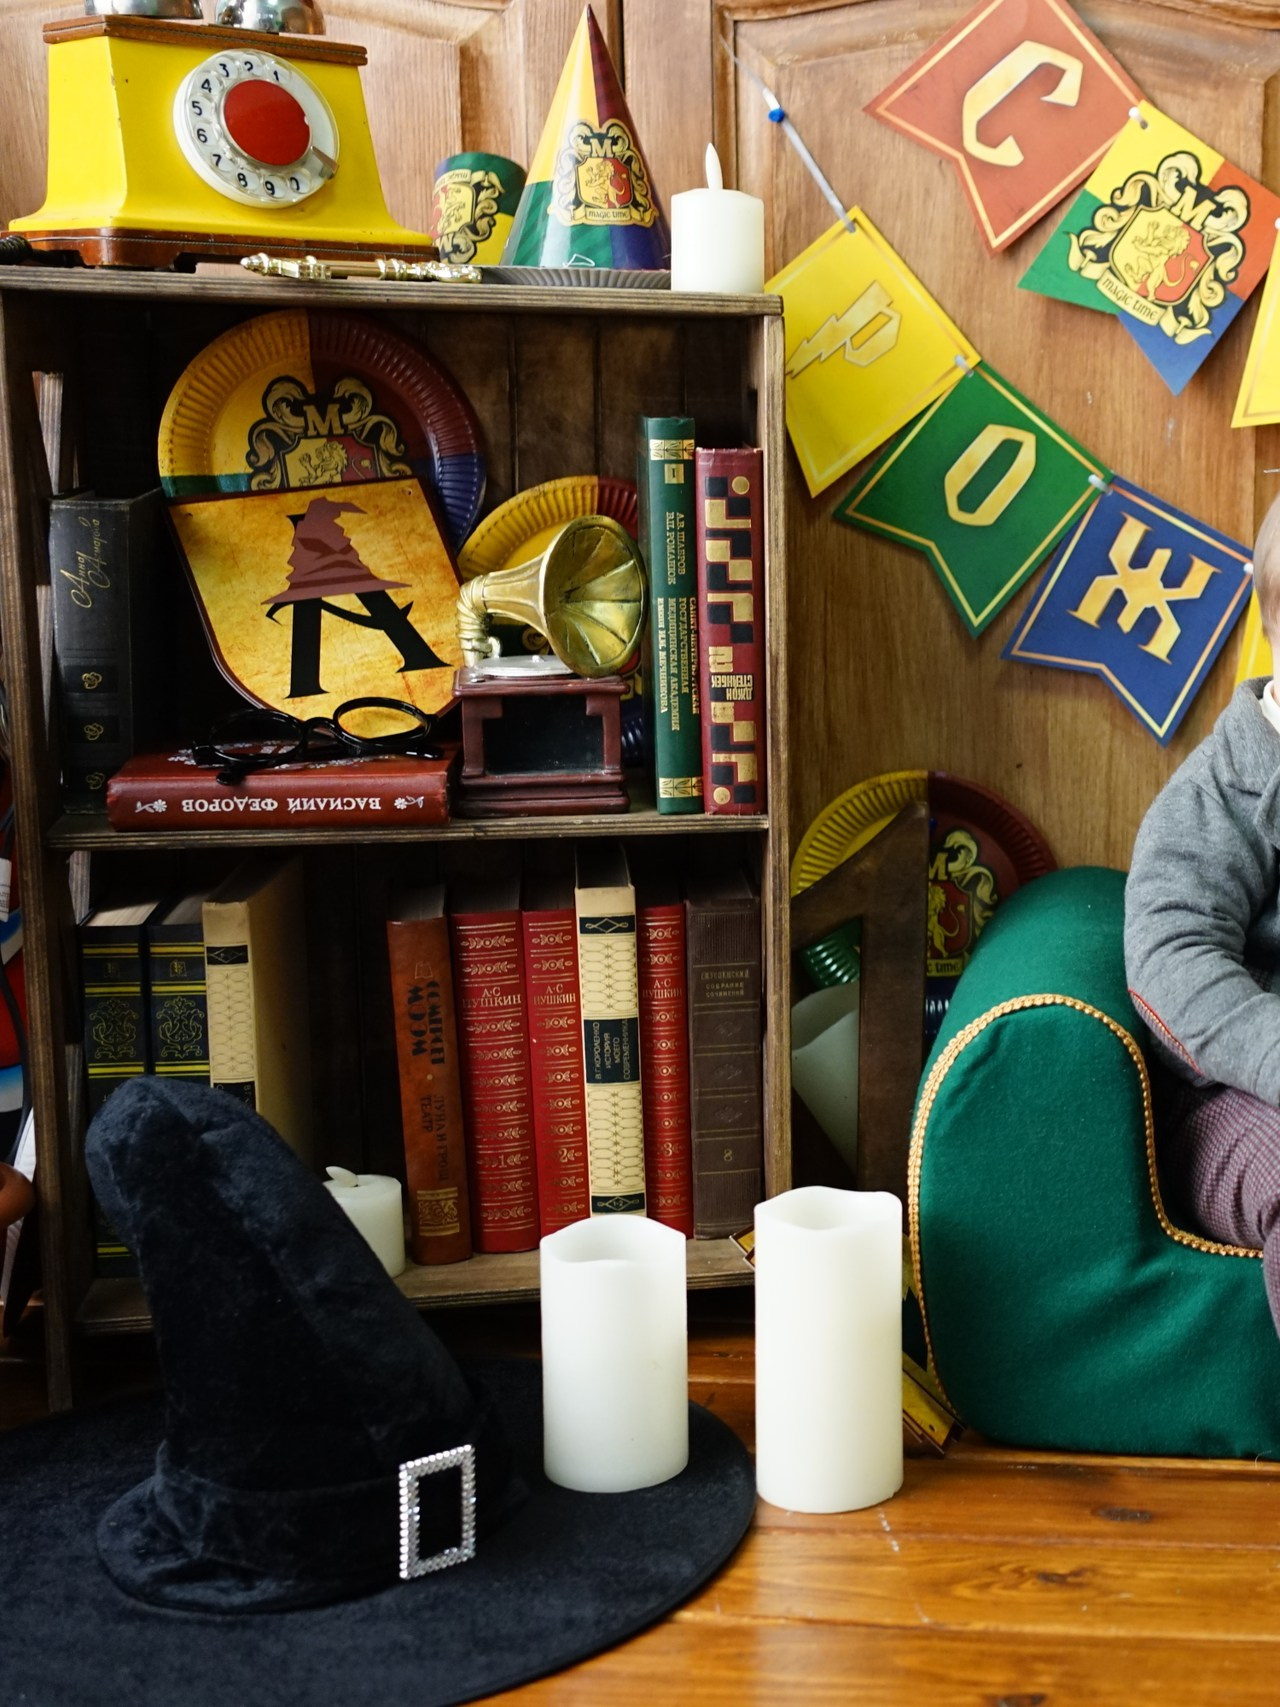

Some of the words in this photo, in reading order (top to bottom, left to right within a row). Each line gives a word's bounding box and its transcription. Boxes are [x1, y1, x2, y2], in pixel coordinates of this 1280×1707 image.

[218, 63, 230, 78] 3
[201, 78, 212, 94] 4
[191, 100, 203, 117] 5
[196, 128, 208, 144] 6
[589, 137, 615, 159] M
[212, 153, 222, 167] 7
[237, 172, 248, 188] 8
[264, 180, 276, 196] 9
[1169, 184, 1217, 232] M
[303, 403, 345, 436] M
[60, 556, 92, 608] Анна
[711, 674, 753, 688] СТЕЙНБЕК
[726, 687, 753, 700] ДЖОН
[180, 797, 279, 814] ФЕДОРОВ
[287, 796, 382, 814] ВАСИЛИЙ
[462, 995, 522, 1008] ПУШКИН
[534, 993, 576, 1006] ПУШКИН
[642, 988, 683, 999] ПУШКИН
[723, 1150, 733, 1162] 8
